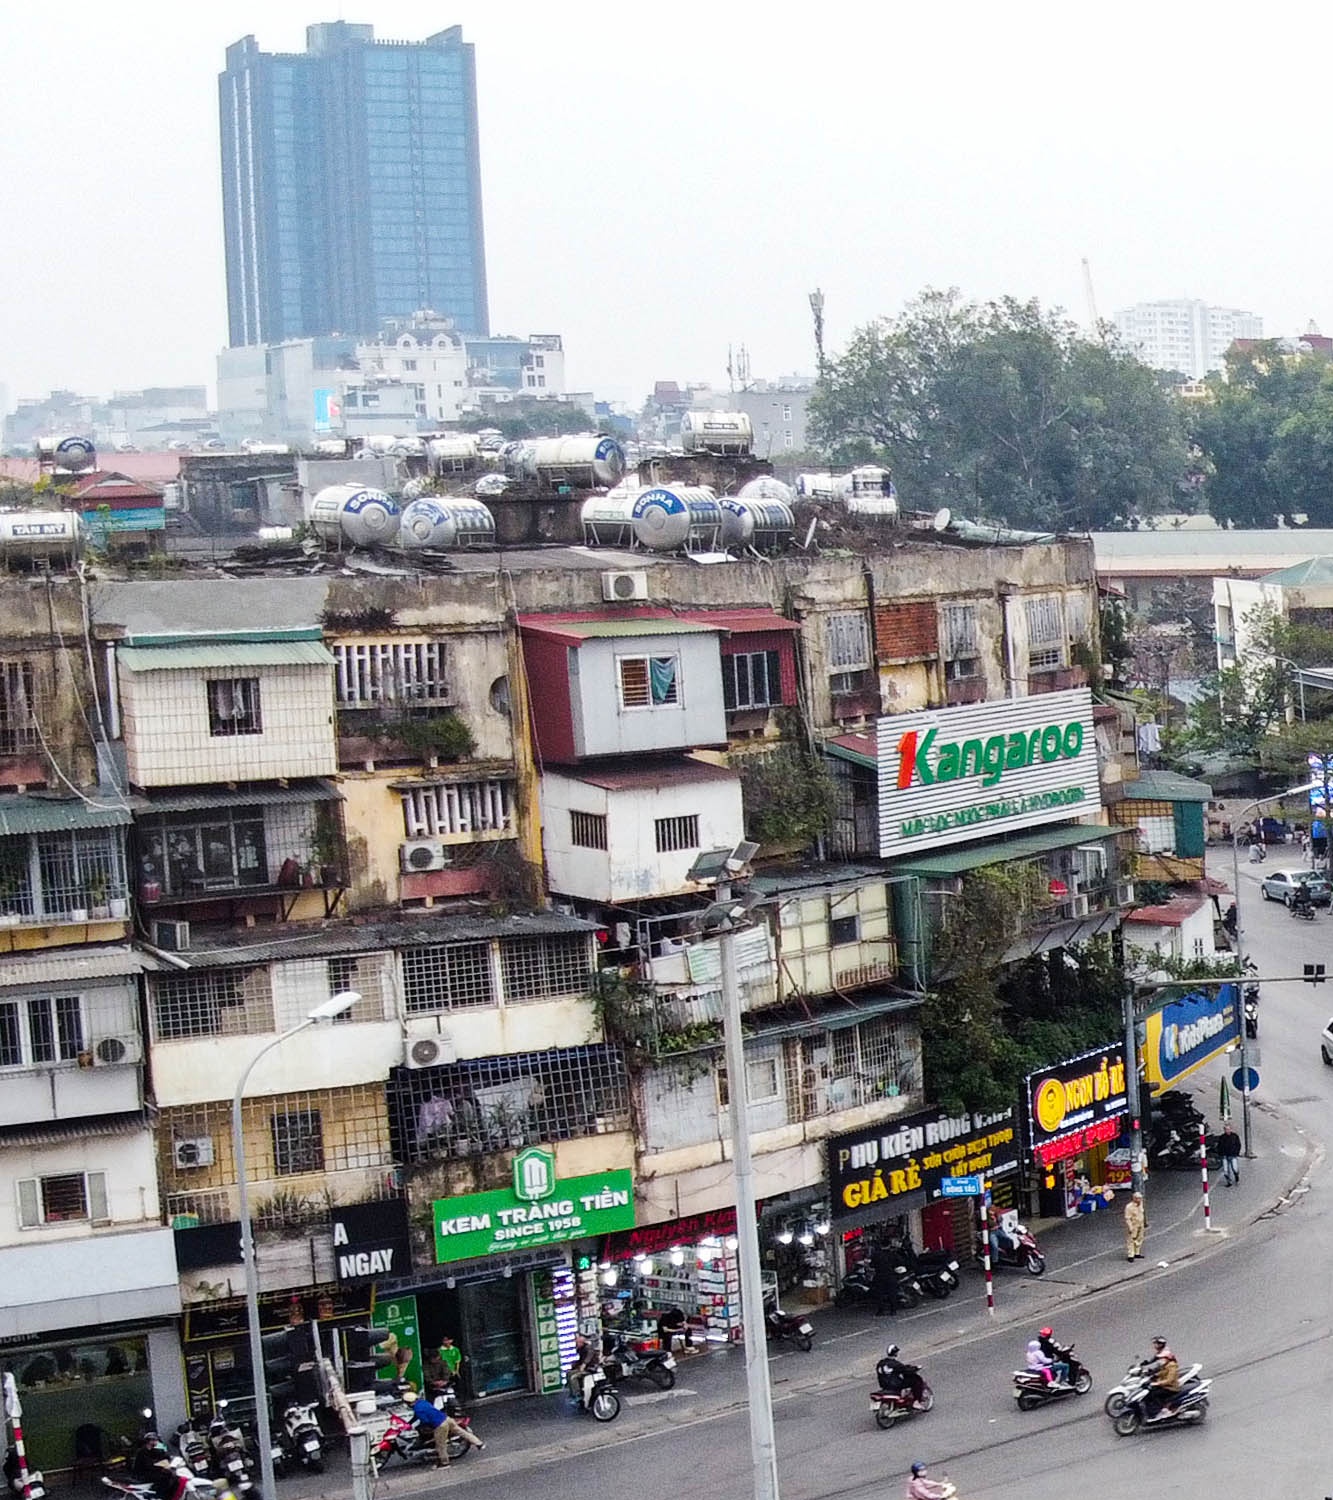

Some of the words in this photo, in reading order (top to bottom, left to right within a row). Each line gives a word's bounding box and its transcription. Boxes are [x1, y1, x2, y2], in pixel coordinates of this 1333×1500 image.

[635, 492, 675, 514] SONHA
[896, 721, 1084, 790] Kangaroo
[839, 1140, 879, 1172] PHỤ
[881, 1125, 924, 1160] KIỆN
[843, 1169, 889, 1208] GIÁ
[890, 1158, 923, 1196] RẺ
[441, 1214, 492, 1237] KEM
[497, 1201, 574, 1226] TRÀNG
[580, 1185, 629, 1212] TIỀN
[494, 1223, 545, 1241] SINCE
[548, 1216, 582, 1232] 1958
[334, 1223, 350, 1247] A
[340, 1249, 394, 1279] NGAY
